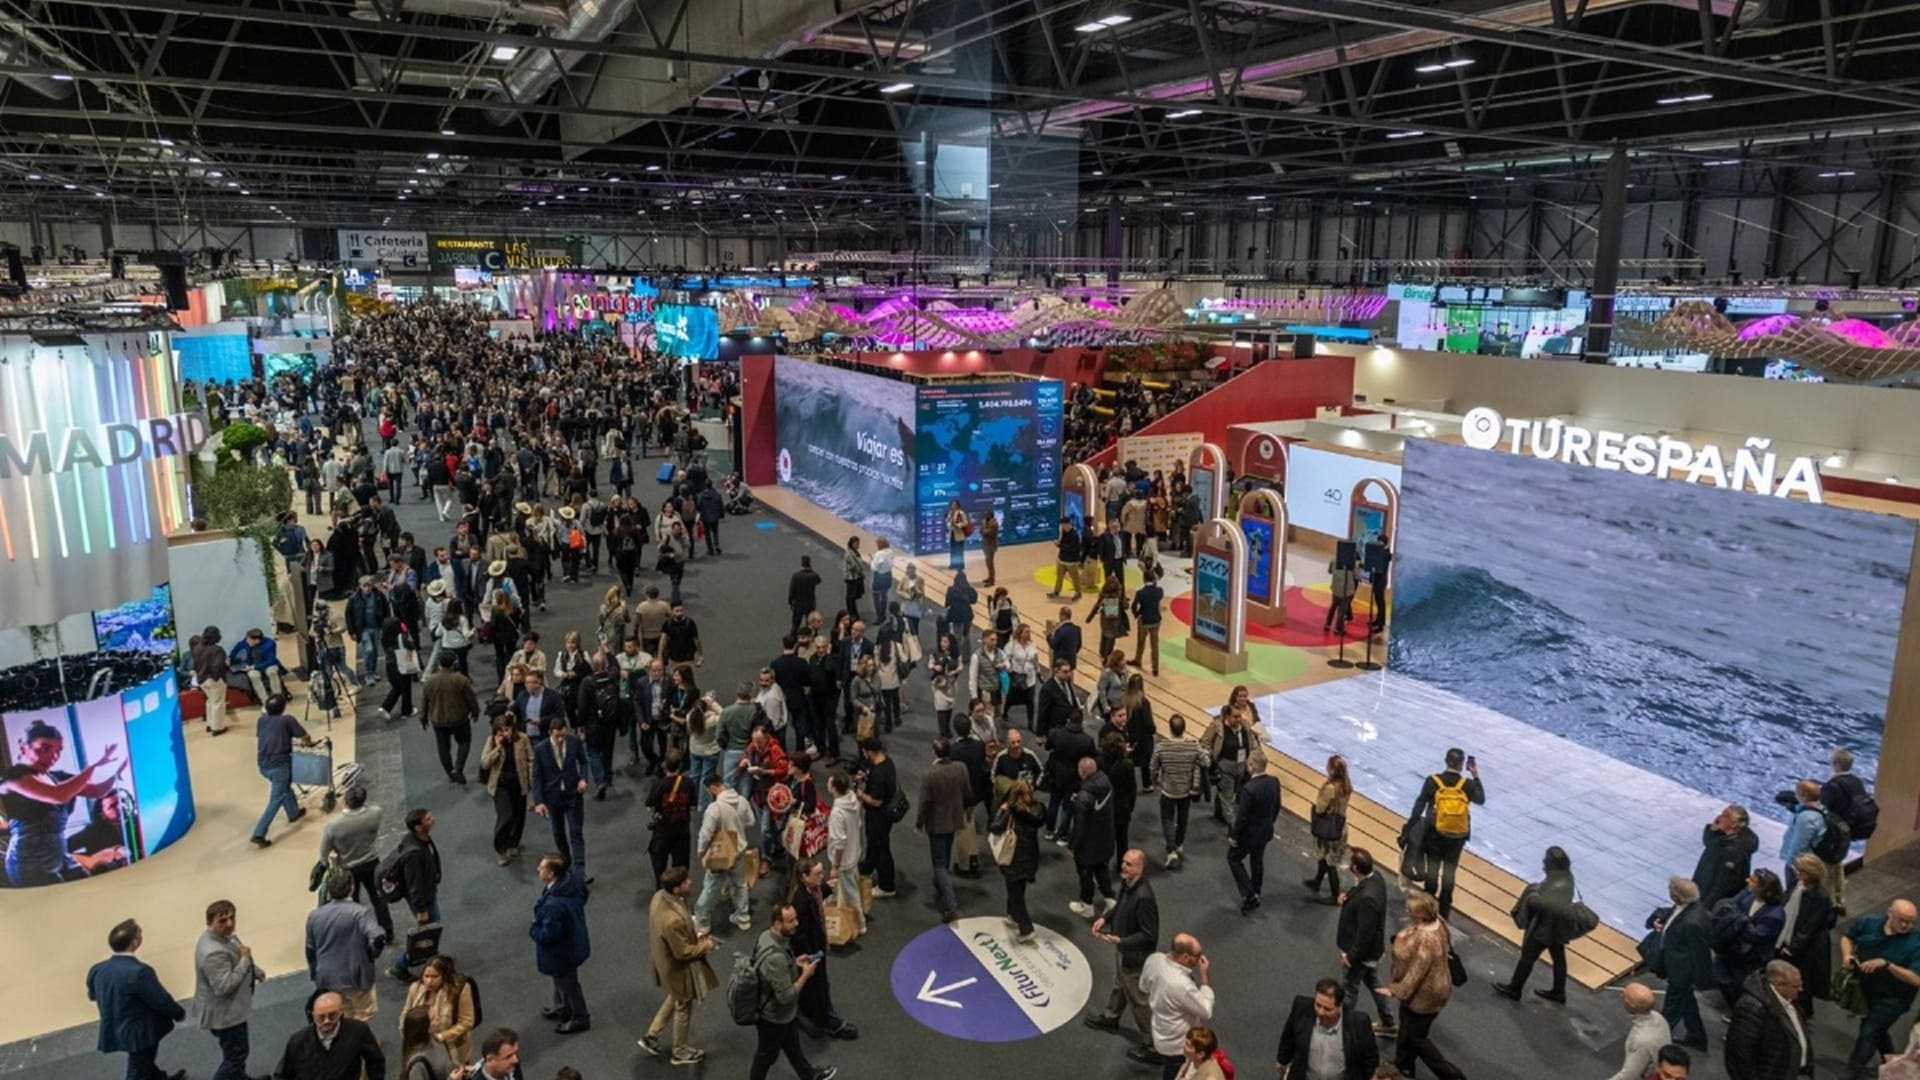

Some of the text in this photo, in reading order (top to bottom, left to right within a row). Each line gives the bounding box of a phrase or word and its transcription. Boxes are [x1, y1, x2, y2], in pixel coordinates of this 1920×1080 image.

[437, 240, 495, 249] RESTAURANTE
[0, 411, 211, 479] MADRID
[856, 431, 887, 462] Viajar
[889, 447, 904, 466] es
[1505, 418, 1824, 504] TURESPAÑA
